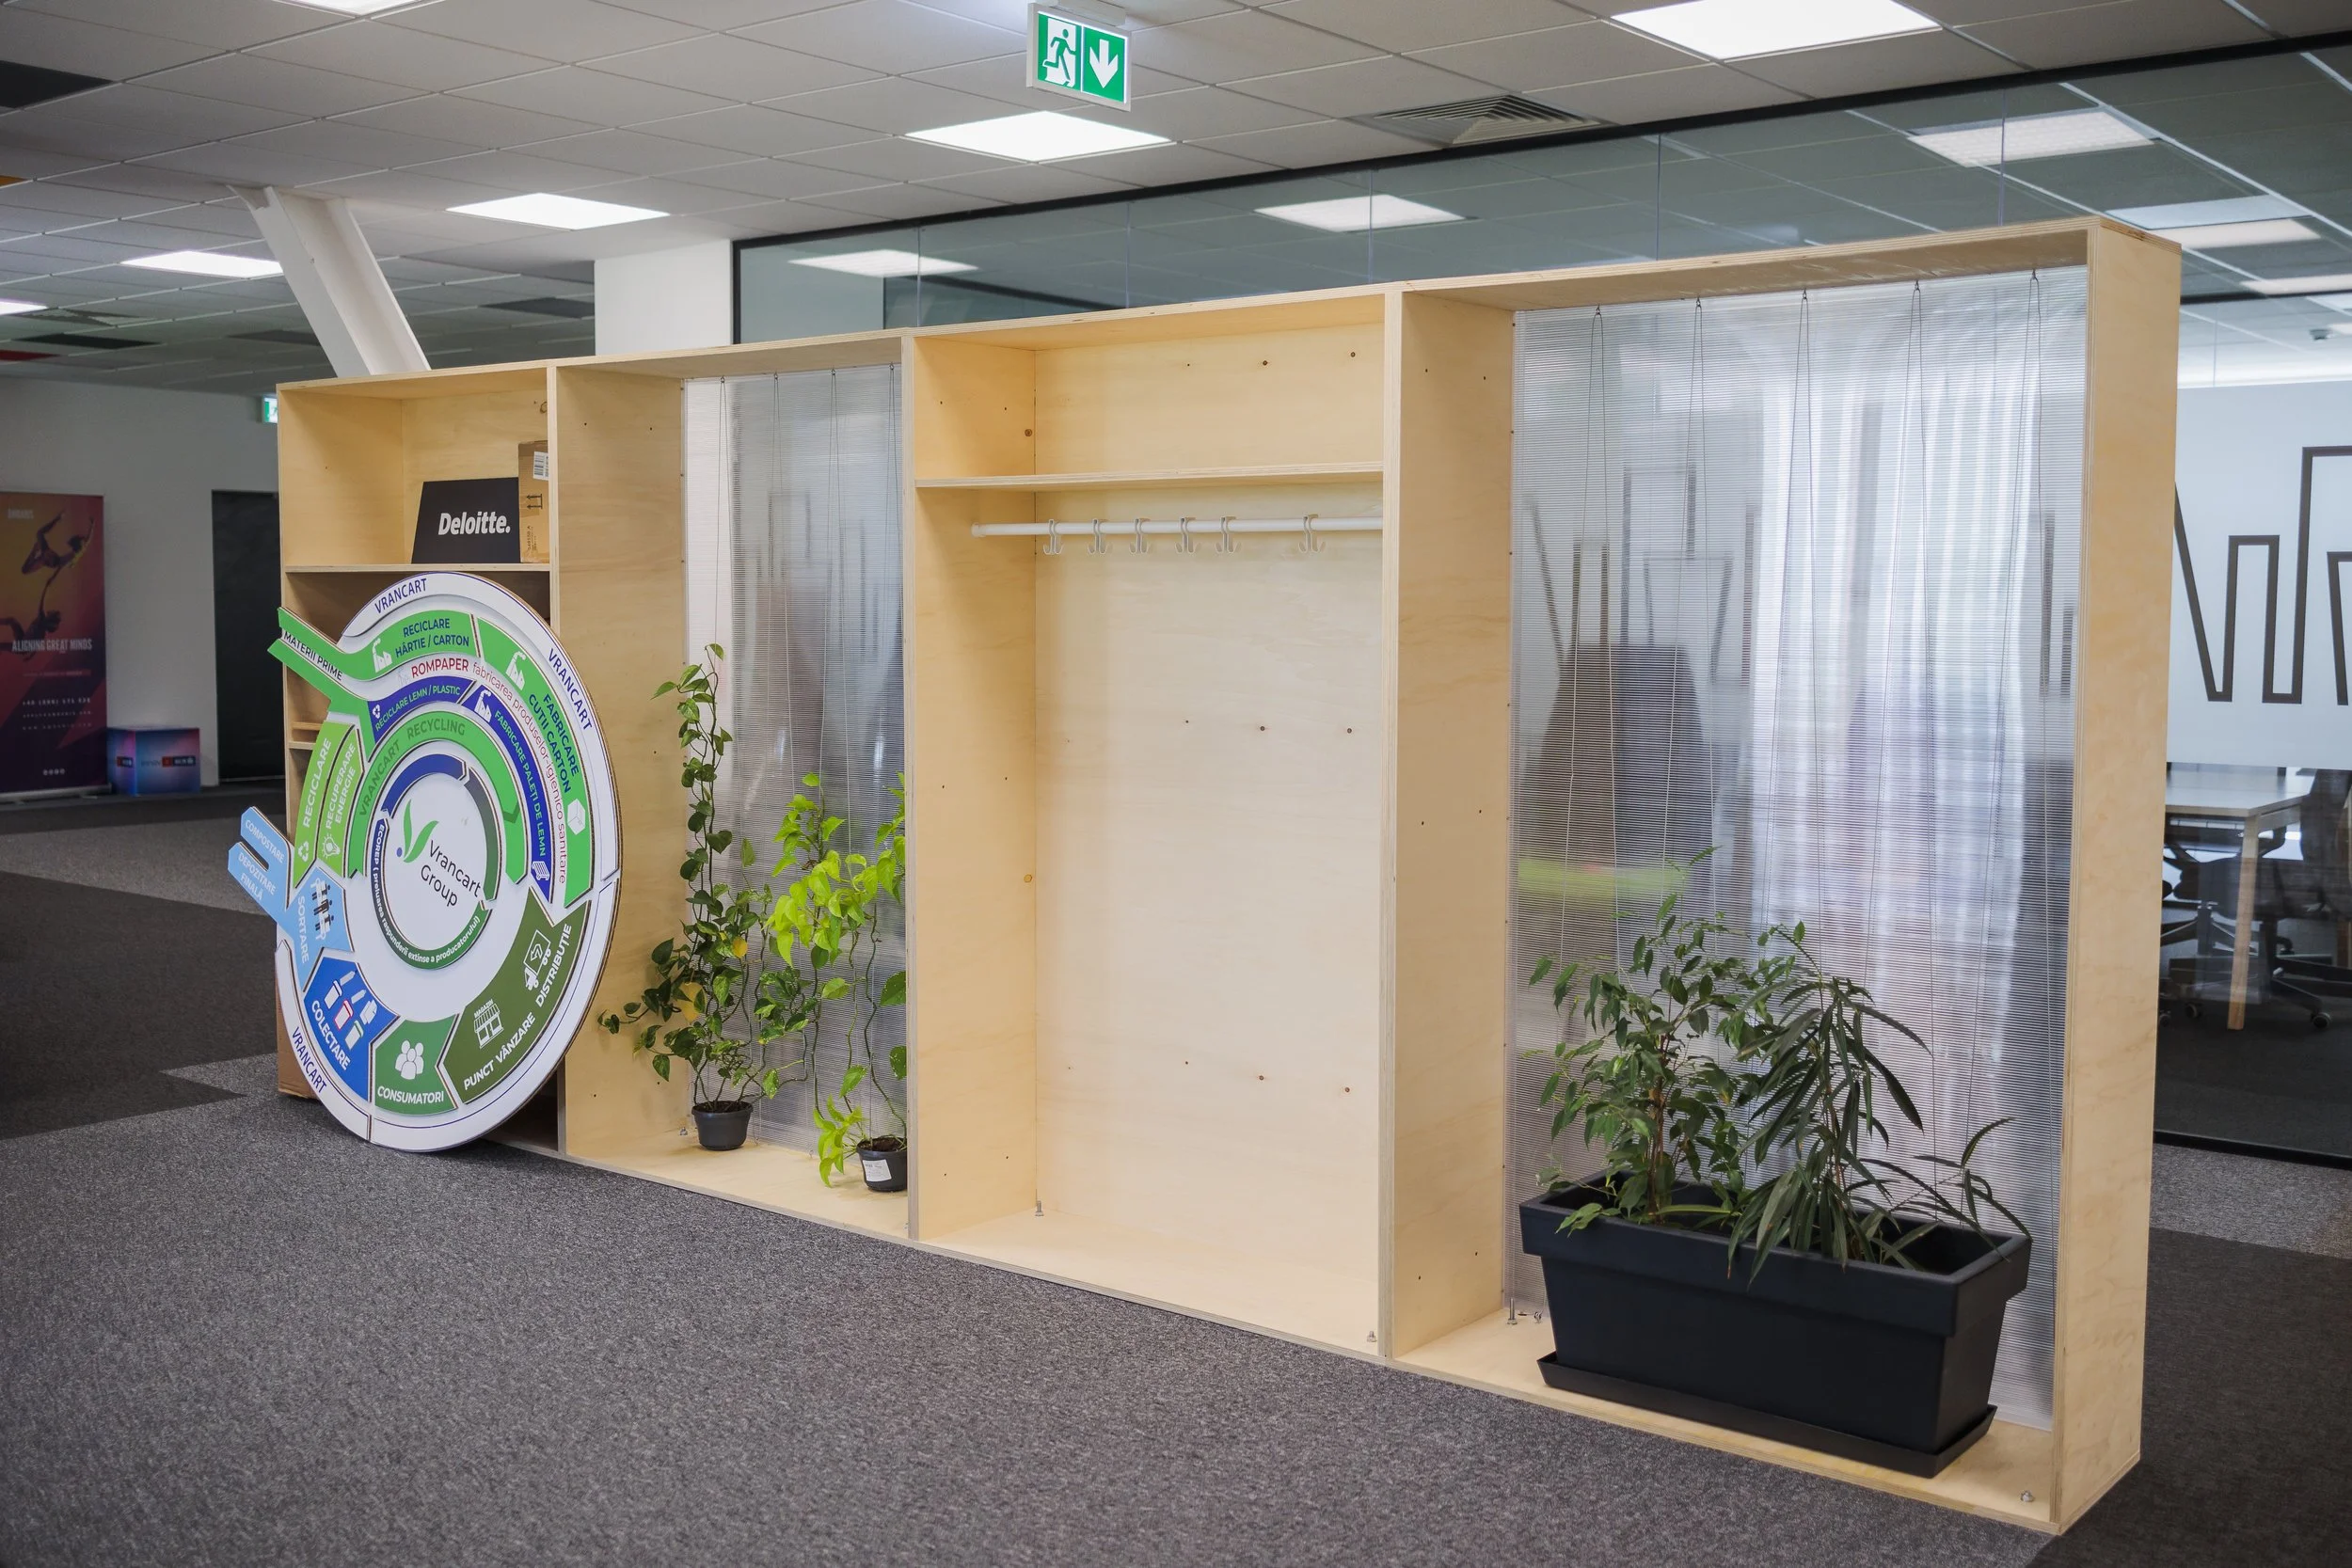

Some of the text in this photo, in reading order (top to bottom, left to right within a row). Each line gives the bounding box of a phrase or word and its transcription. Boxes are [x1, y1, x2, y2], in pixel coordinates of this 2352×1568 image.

[437, 511, 511, 535] Deloitte.
[374, 578, 427, 614] VRANCART
[12, 637, 92, 652] ALIGNING GREAT MINDS
[395, 634, 469, 657] HÂRTIE / CARTON
[403, 618, 450, 638] RECICLARE
[283, 631, 343, 681] MATERII PRIME
[374, 698, 408, 732] RECICLARE
[407, 688, 428, 703] LEMN
[432, 685, 461, 695] PLASTIC
[548, 648, 593, 731] VRANCART
[494, 710, 527, 763] FABRICARE
[529, 693, 571, 794] CUTII CARTON
[543, 693, 580, 777] FABRICARE
[302, 737, 331, 829] RECICLARE
[326, 743, 356, 830] RECUPERARE
[359, 718, 466, 816] VRANCART RECYCLING
[411, 657, 469, 678] ROMPAPER
[472, 661, 513, 701] fabricarea
[558, 823, 567, 884] sanitare
[335, 766, 356, 824] ENERGIE
[533, 803, 543, 820] DE
[245, 819, 285, 863] COMPOSTARE
[536, 822, 546, 857] LEMN
[238, 852, 277, 895] DEPOZITARE
[373, 824, 385, 865] ECOREP
[407, 952, 430, 963] extinse
[421, 864, 458, 907] Group
[429, 839, 481, 897] Vrancart
[297, 895, 310, 964] SORTARE
[292, 1026, 327, 1093] VRANCART
[311, 1000, 351, 1071] COLECTARE
[463, 1011, 536, 1090] PUNCT VÂNZARE
[377, 1085, 444, 1104] CONSUMATORI
